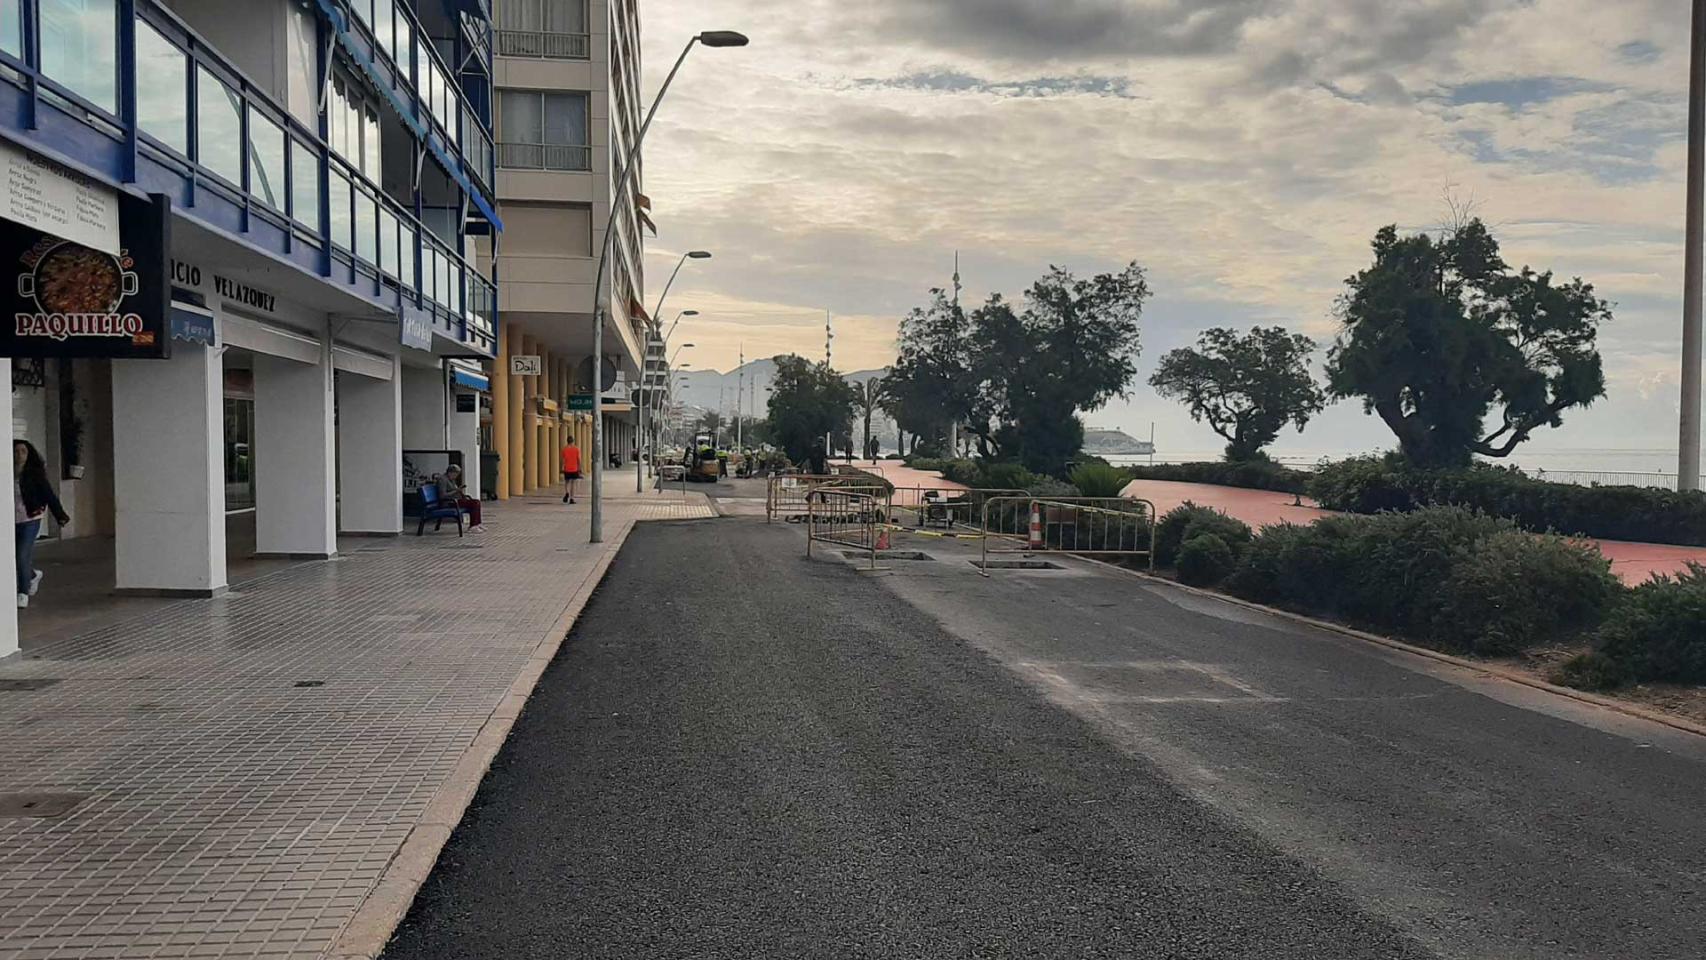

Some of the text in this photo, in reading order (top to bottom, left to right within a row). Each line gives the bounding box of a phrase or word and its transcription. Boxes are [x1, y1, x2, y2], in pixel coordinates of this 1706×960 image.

[170, 259, 275, 312] ICIO VELAZQUEZ
[15, 312, 143, 341] PAQUILLO
